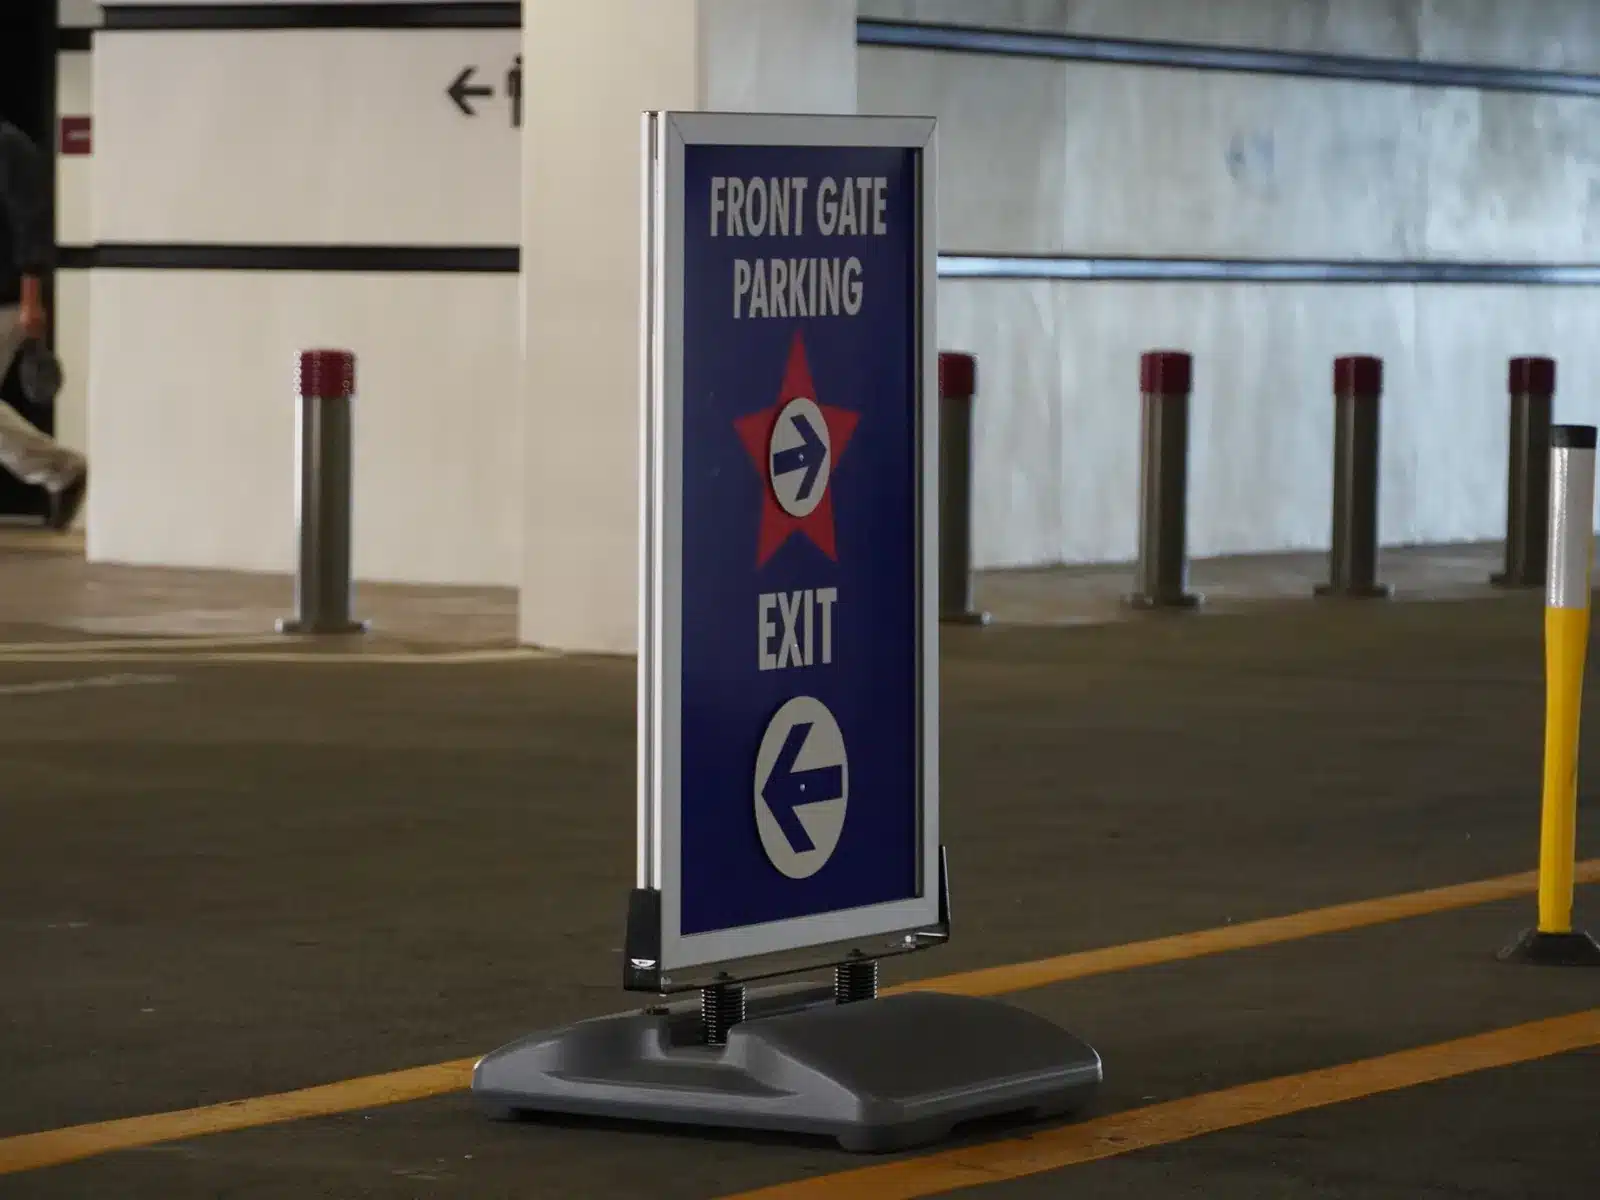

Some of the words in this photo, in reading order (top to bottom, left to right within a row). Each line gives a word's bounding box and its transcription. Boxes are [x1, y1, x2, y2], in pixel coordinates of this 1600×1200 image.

[710, 176, 808, 237] FRONT
[816, 176, 888, 236] GATE
[733, 256, 864, 319] PARKING
[758, 587, 838, 671] EXIT
